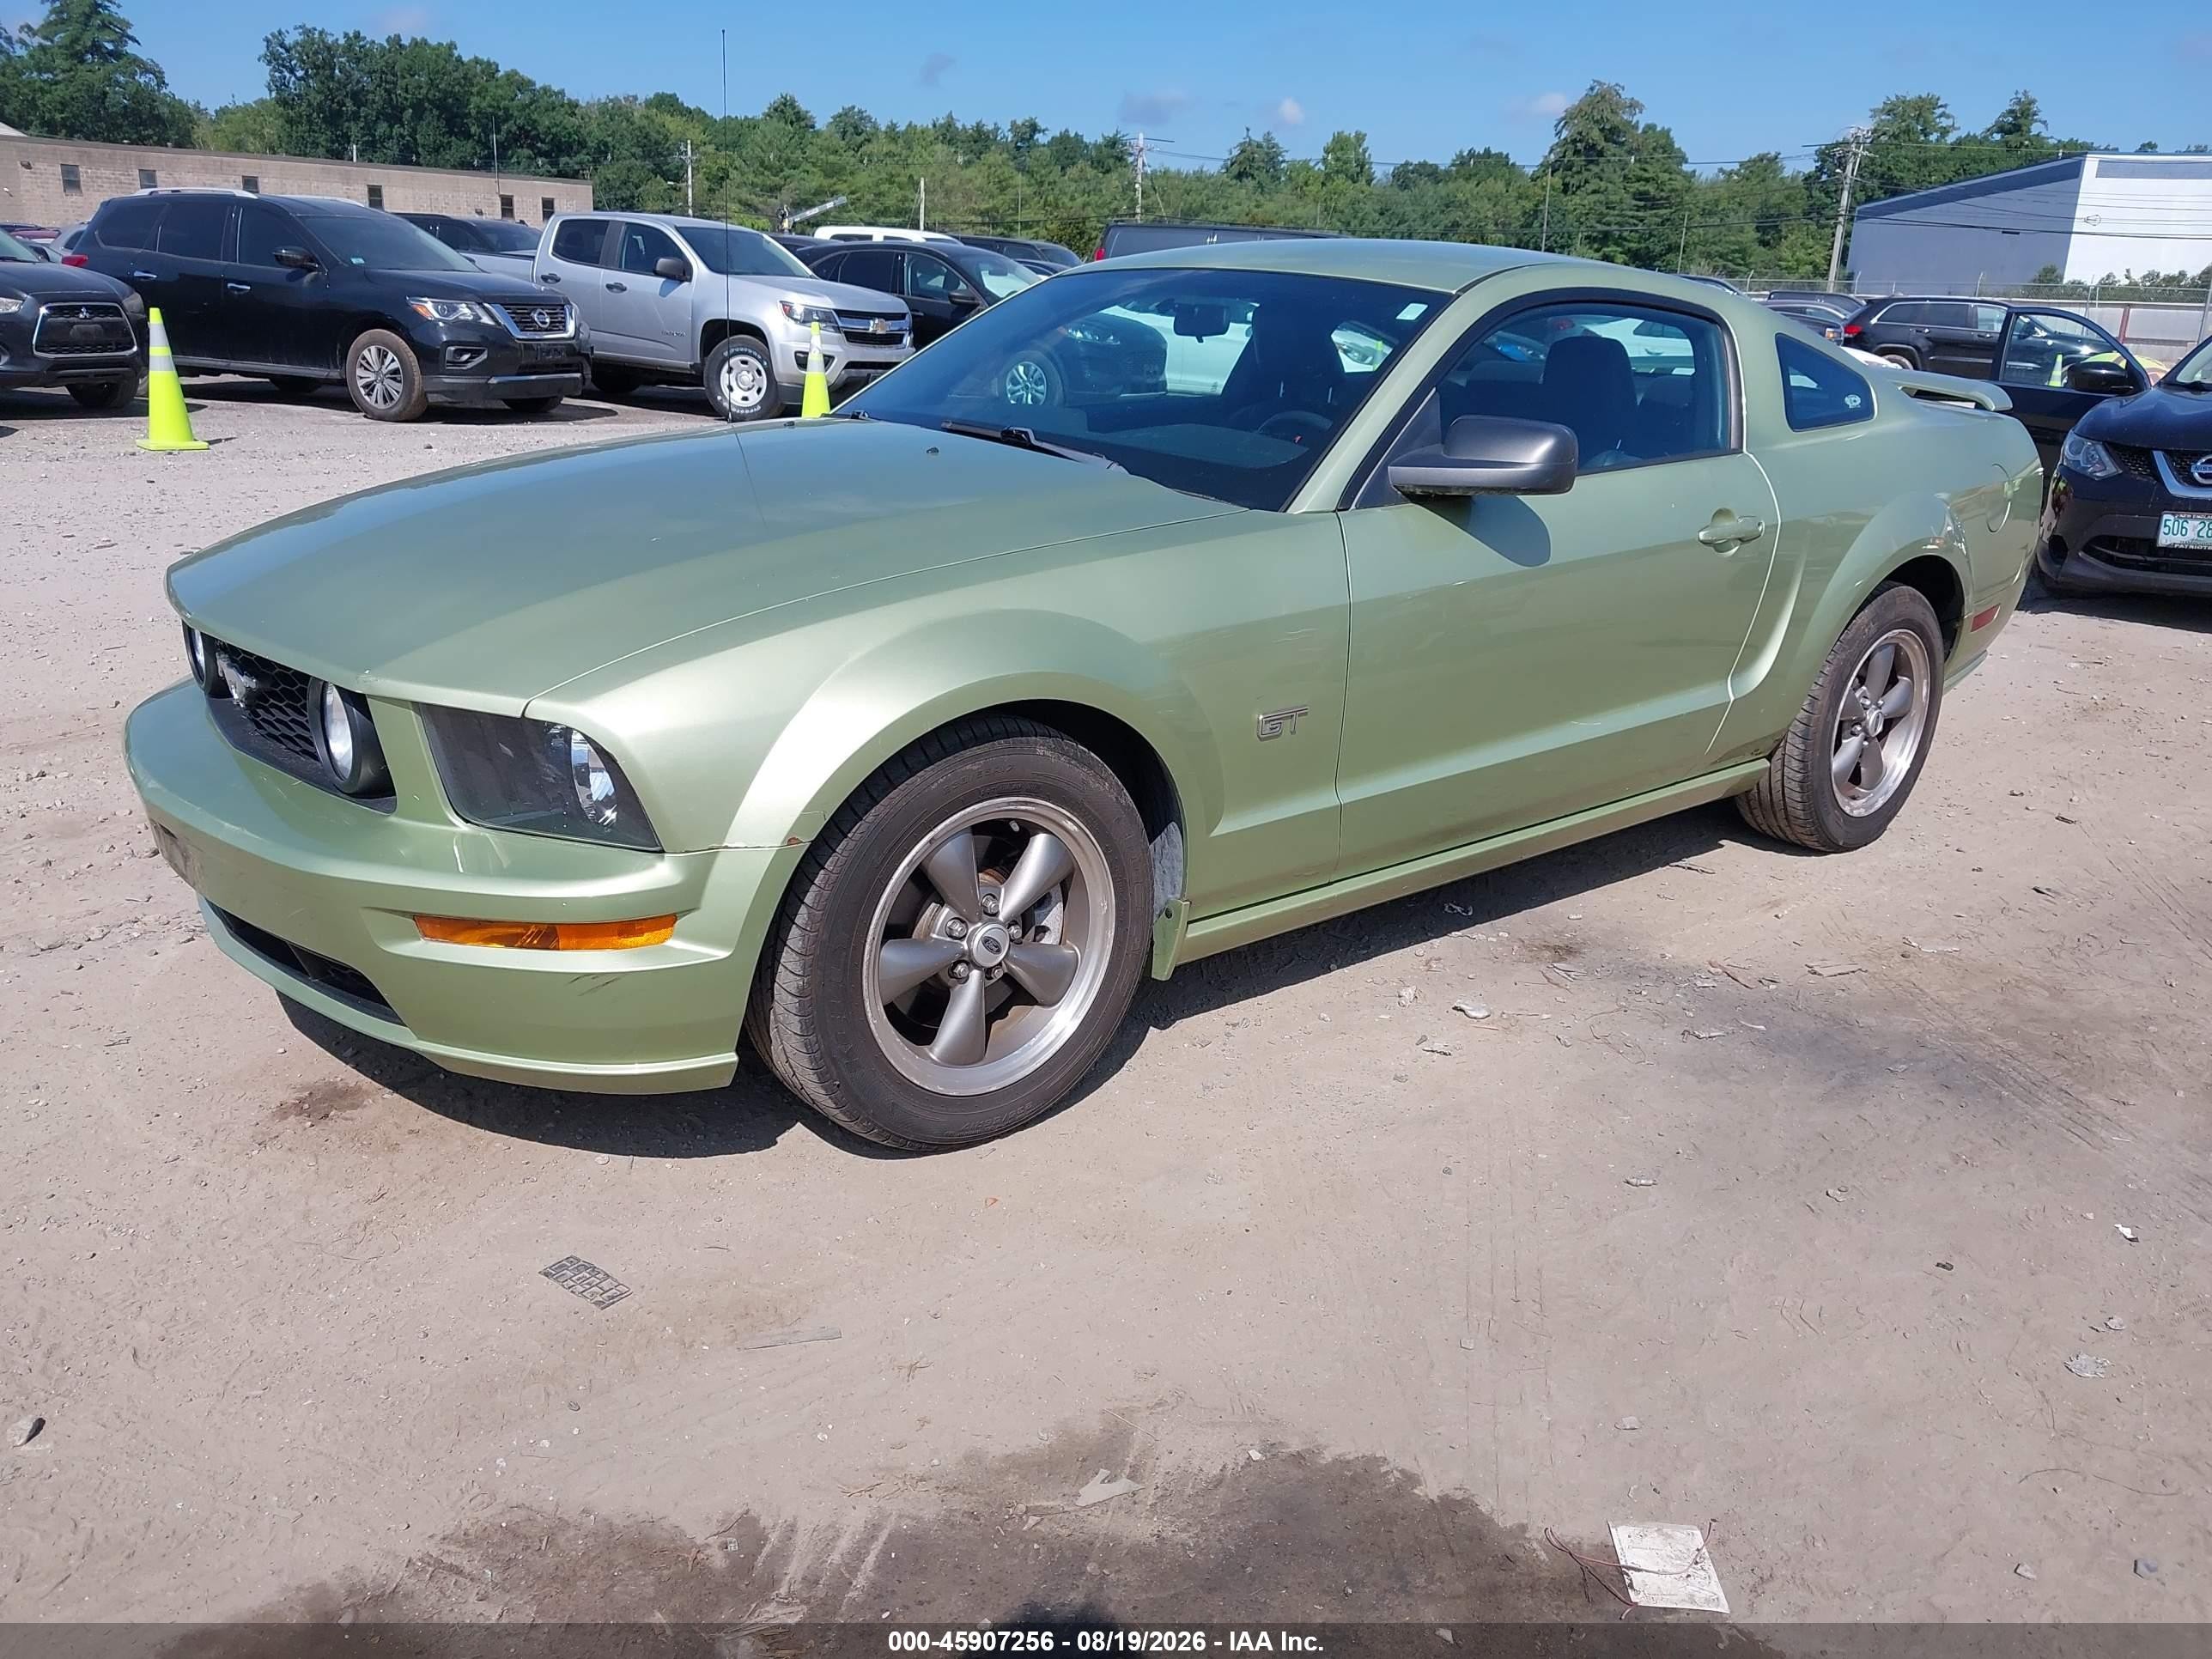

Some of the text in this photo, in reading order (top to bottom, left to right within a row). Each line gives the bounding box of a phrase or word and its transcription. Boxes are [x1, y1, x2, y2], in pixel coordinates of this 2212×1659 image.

[2163, 519, 2212, 538] 506 28
[1257, 705, 1309, 742] GT
[985, 939, 1000, 952] Ford
